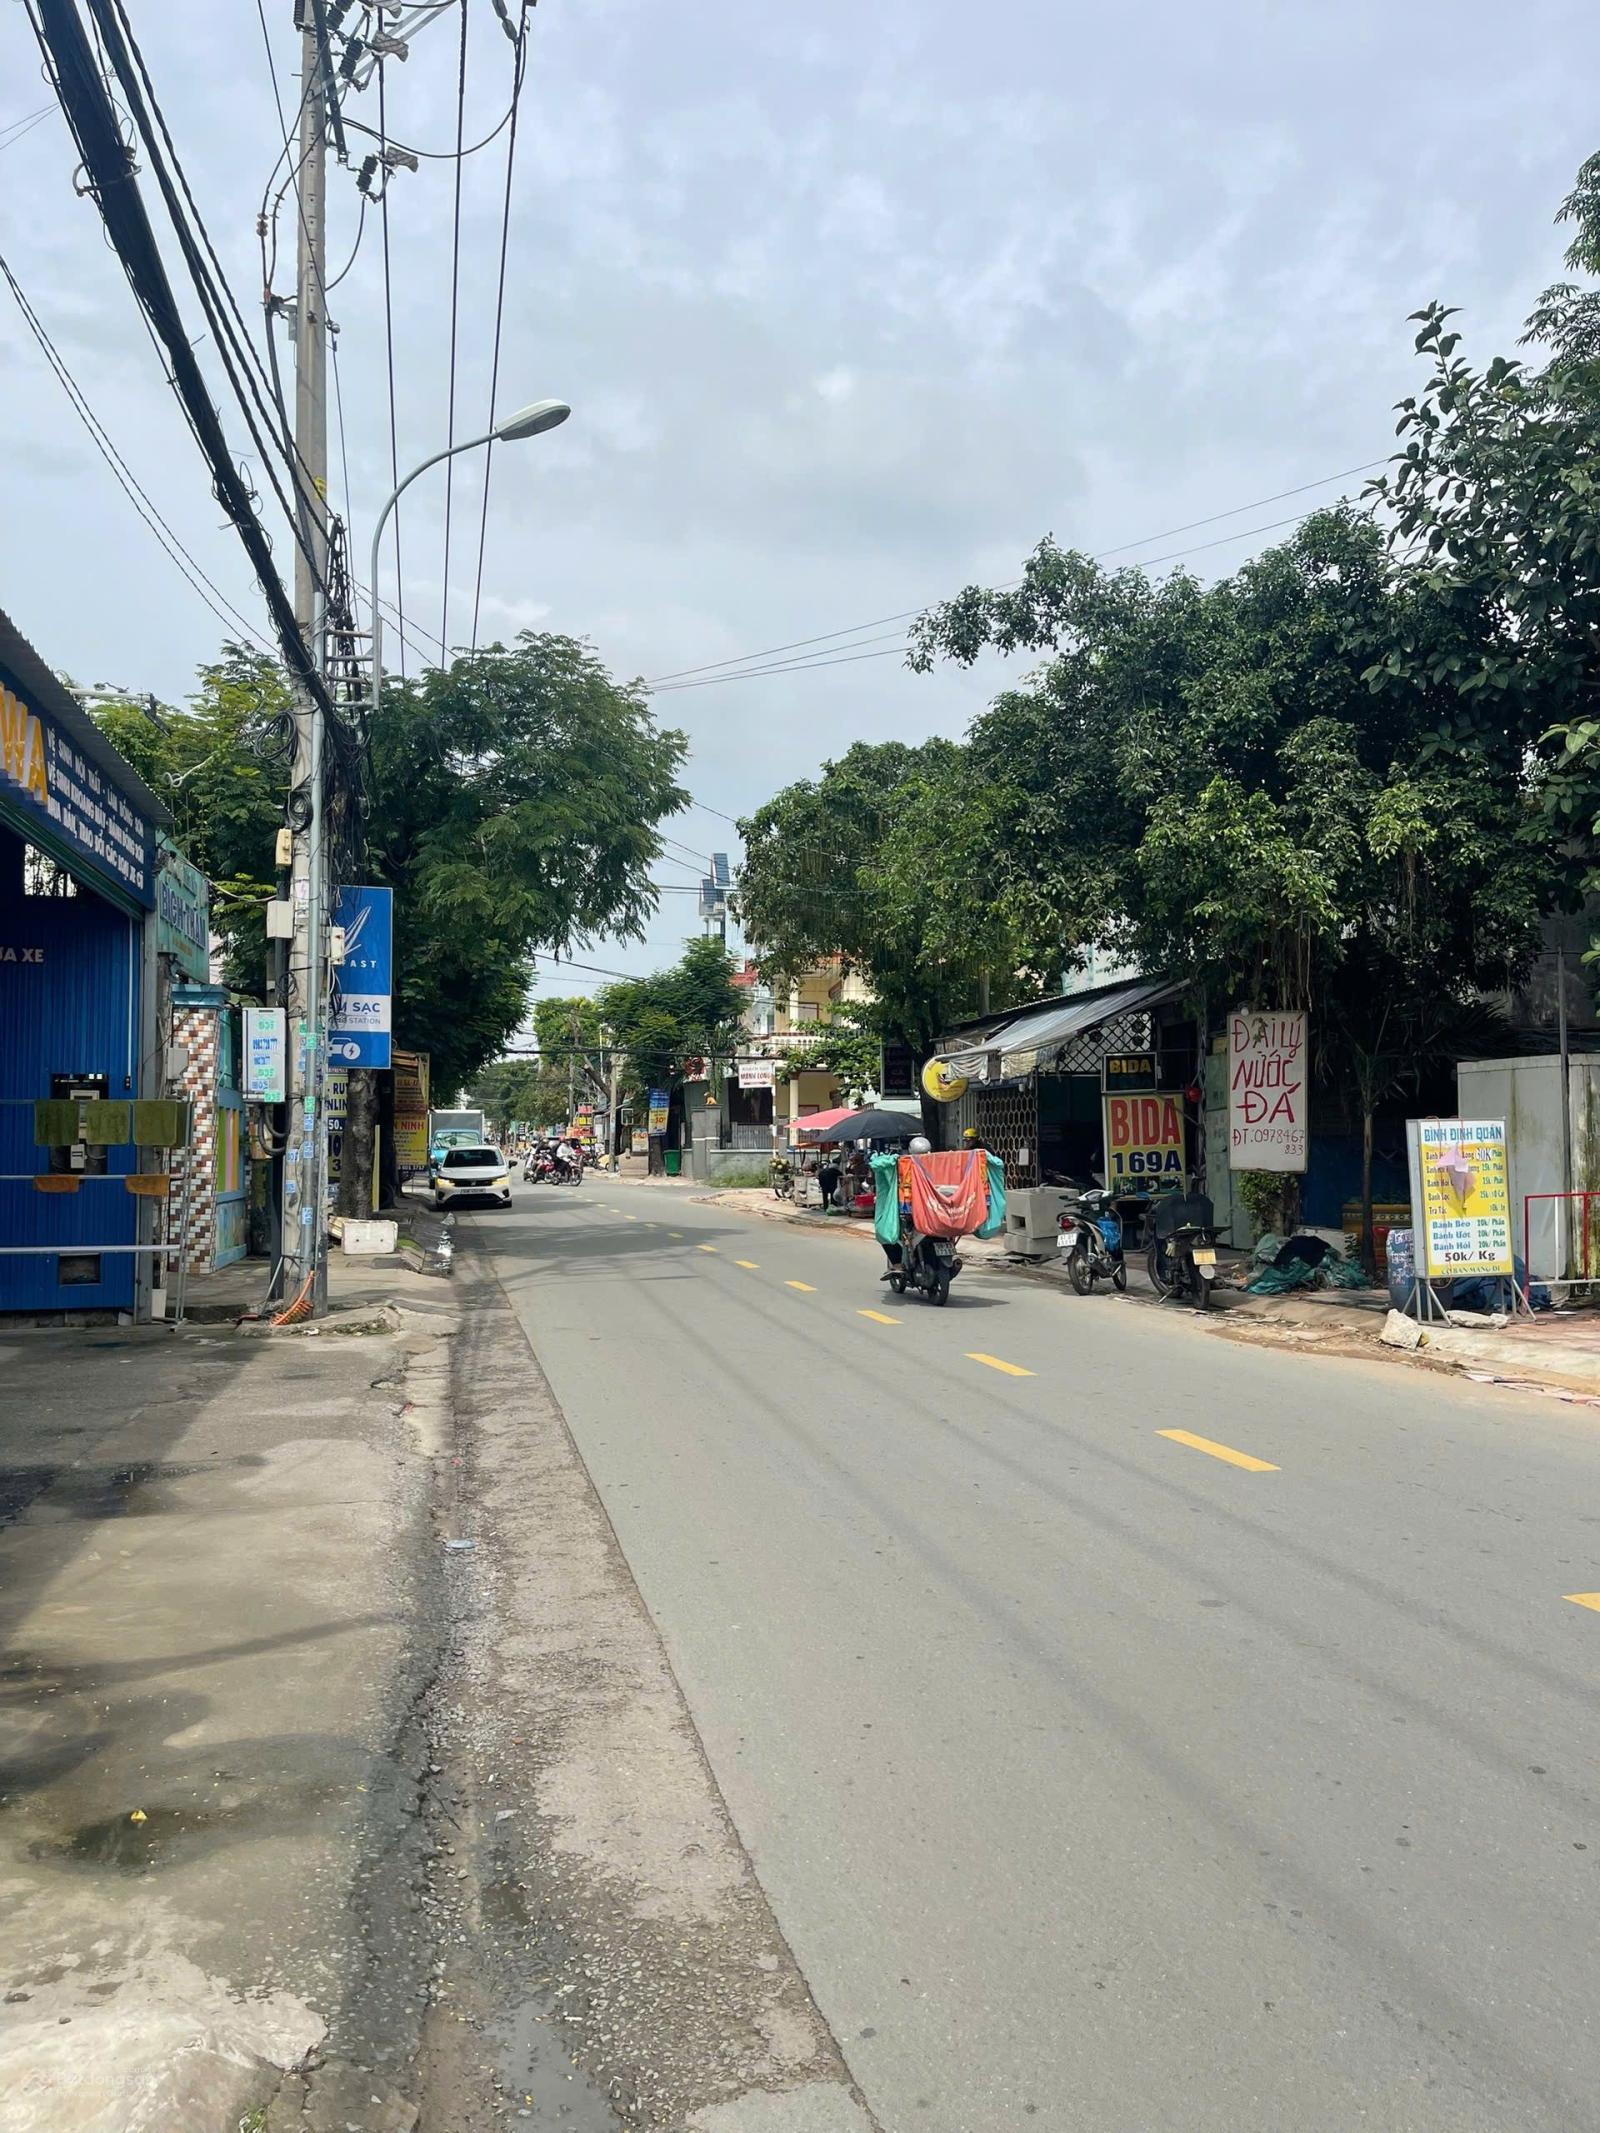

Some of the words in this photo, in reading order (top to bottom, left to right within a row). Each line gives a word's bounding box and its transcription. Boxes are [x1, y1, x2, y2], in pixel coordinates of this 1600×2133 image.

[21, 947, 45, 964] XE
[353, 1002, 380, 1015] SẠC
[348, 1016, 381, 1025] STATION
[1109, 1059, 1152, 1074] BIDA
[1236, 1082, 1302, 1124] ĐÁ
[1110, 1098, 1181, 1147] BIDA
[1424, 1126, 1447, 1142] BÌNH
[1476, 1124, 1502, 1142] QUÁN
[1112, 1150, 1182, 1174] 169A
[1444, 1251, 1474, 1262] 50k/
[1478, 1250, 1496, 1261] Kg
